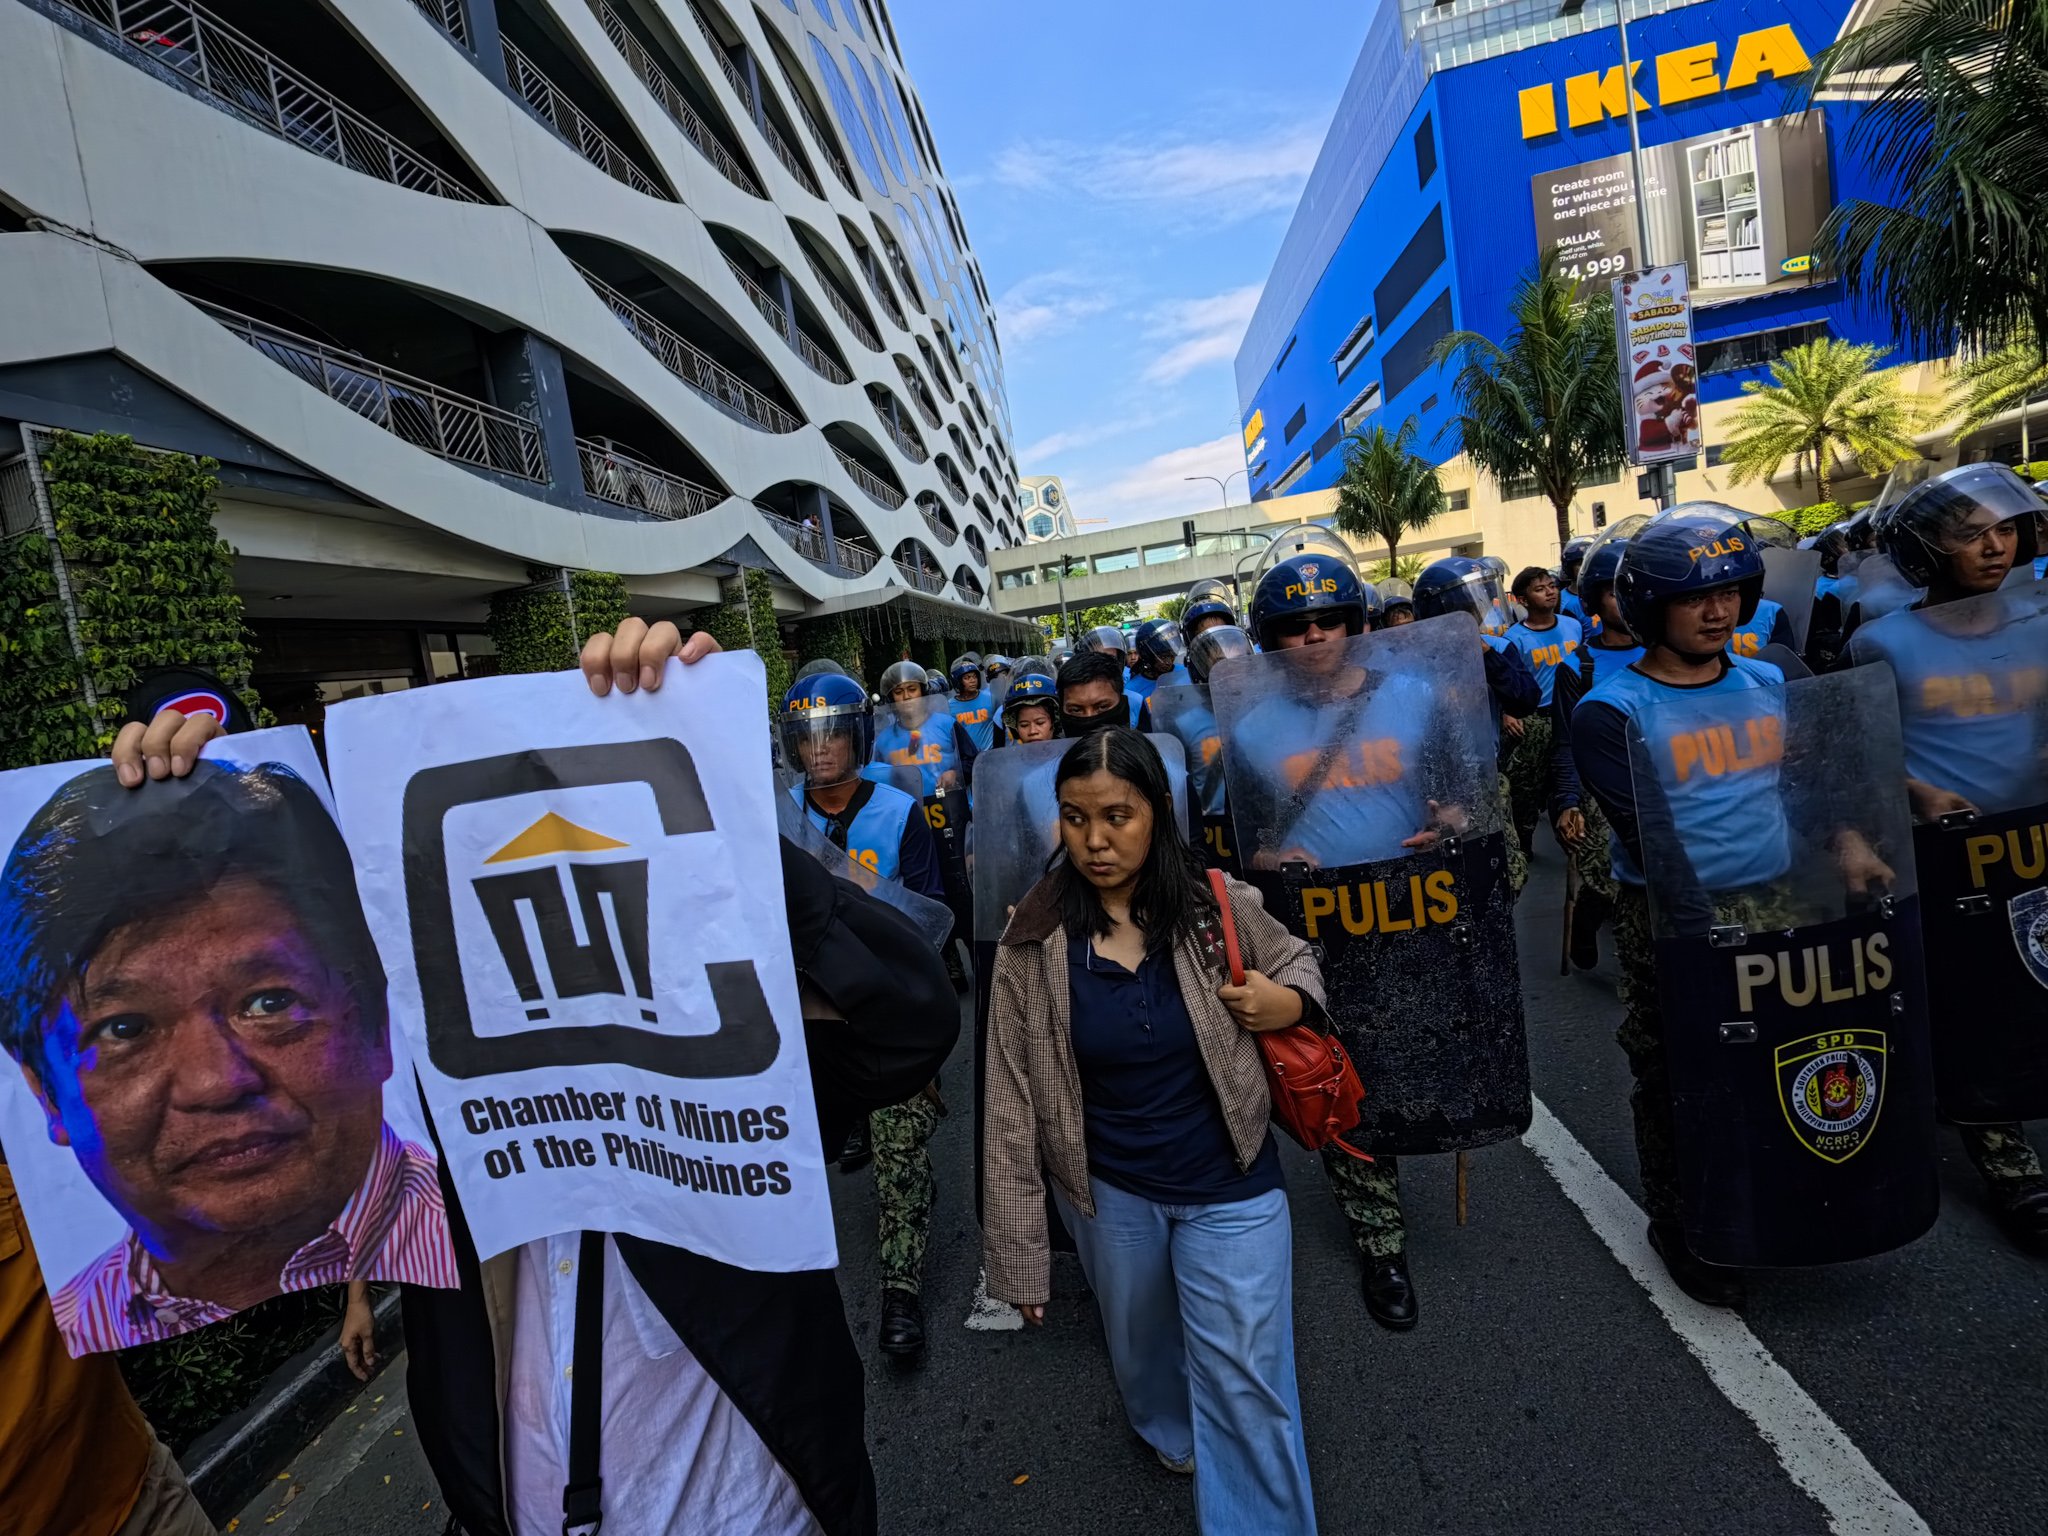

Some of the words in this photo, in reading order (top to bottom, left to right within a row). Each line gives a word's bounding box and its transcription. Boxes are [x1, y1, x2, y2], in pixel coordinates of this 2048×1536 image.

[1518, 23, 1813, 140] IKEA
[1550, 177, 1591, 195] Create
[1593, 170, 1625, 185] room
[1551, 195, 1571, 208] for
[1572, 187, 1604, 203] what
[1605, 181, 1629, 197] you
[1631, 176, 1660, 191] le,
[1553, 208, 1577, 221] one
[1578, 200, 1611, 218] piece
[1612, 196, 1627, 207] at
[1628, 194, 1637, 204] a
[1645, 186, 1668, 200] ime
[1556, 229, 1602, 248] KALLAX
[1578, 251, 1589, 259] cm
[1785, 260, 1807, 269] IKE
[1637, 305, 1678, 319] SABADO
[1630, 321, 1671, 338] SABADO
[1688, 536, 1745, 563] PULIS
[1284, 578, 1338, 601] PULIS
[789, 696, 827, 713] PULS
[956, 708, 989, 725] PULIS
[1670, 715, 1783, 783] PULIS
[1965, 823, 2048, 889] PU
[1301, 869, 1460, 939] PULIS
[1734, 931, 1894, 1013] PULIS
[1816, 1033, 1855, 1050] SPD
[1796, 1058, 1827, 1091] SOUTHERN
[1826, 1051, 1848, 1064] POLIC
[460, 1086, 626, 1136] Chamber
[634, 1093, 667, 1132] of
[671, 1097, 790, 1144] Mines
[1795, 1100, 1827, 1130] PHILIPPINE
[1826, 1117, 1860, 1131] NATIONAL
[483, 1139, 526, 1180] of
[532, 1134, 597, 1169] the
[600, 1131, 792, 1197] Philippines
